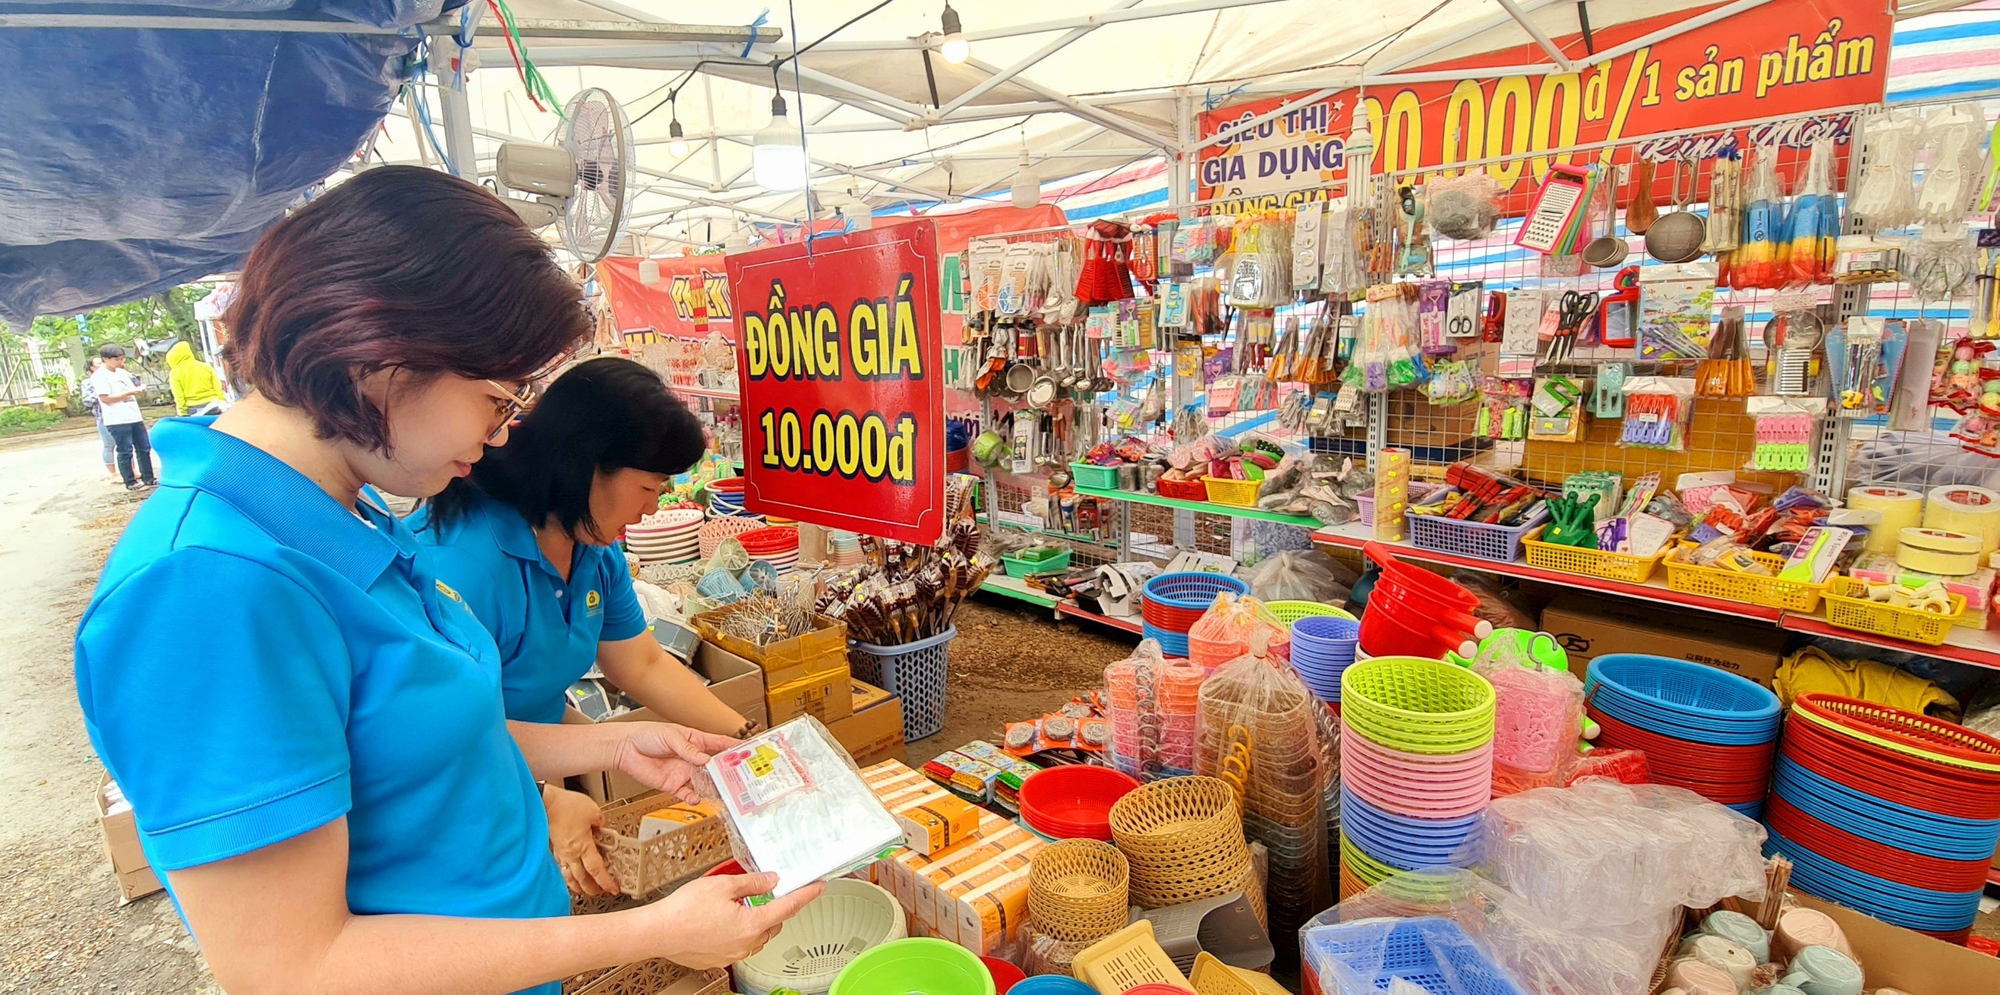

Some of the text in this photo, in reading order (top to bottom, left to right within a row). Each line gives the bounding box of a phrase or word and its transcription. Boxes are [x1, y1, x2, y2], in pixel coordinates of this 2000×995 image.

[1674, 44, 1745, 101] sản
[1755, 17, 1876, 99] phẩm
[1284, 103, 1328, 134] THỊ
[1203, 140, 1344, 185] GIA DỤNG
[744, 278, 841, 381] ĐỒNG
[848, 273, 924, 380] GIÁ
[760, 407, 917, 486] 10.000đ
